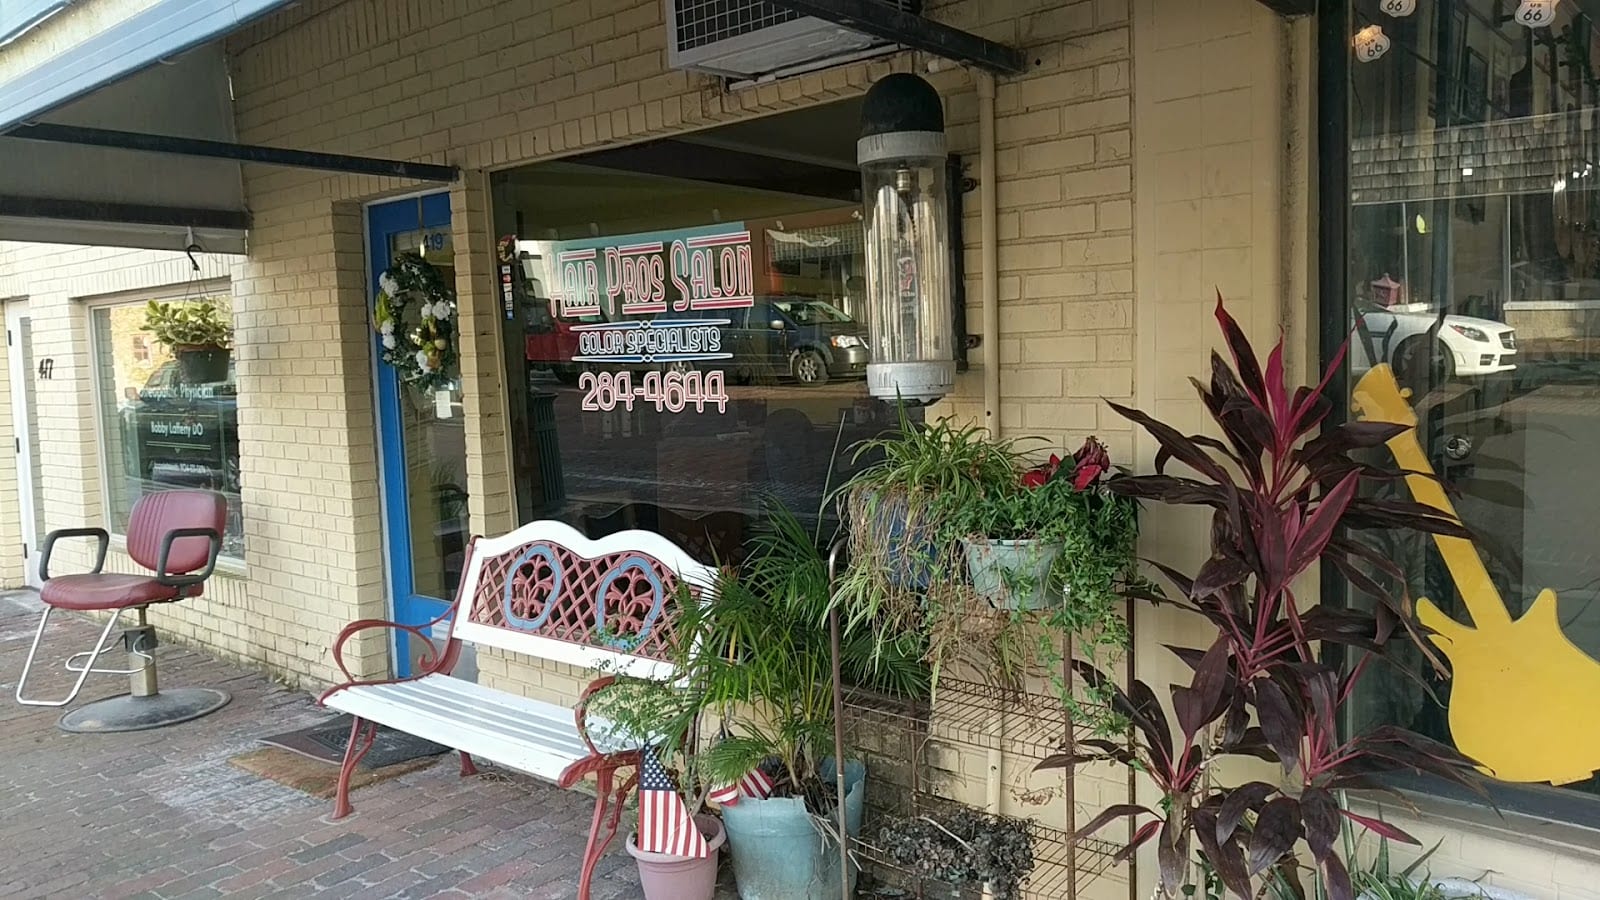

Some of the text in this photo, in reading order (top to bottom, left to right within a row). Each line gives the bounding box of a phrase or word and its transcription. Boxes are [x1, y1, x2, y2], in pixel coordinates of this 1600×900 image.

[1387, 0, 1402, 11] 66
[1523, 9, 1542, 21] 66
[1368, 43, 1383, 57] 66
[605, 243, 666, 315] PROS
[670, 236, 754, 312] SALON
[579, 326, 722, 354] COLOR SPECIALISTS
[180, 383, 214, 402] Physician
[578, 370, 729, 414] 284-4644
[151, 421, 204, 438] Bobby Lafferty DO
